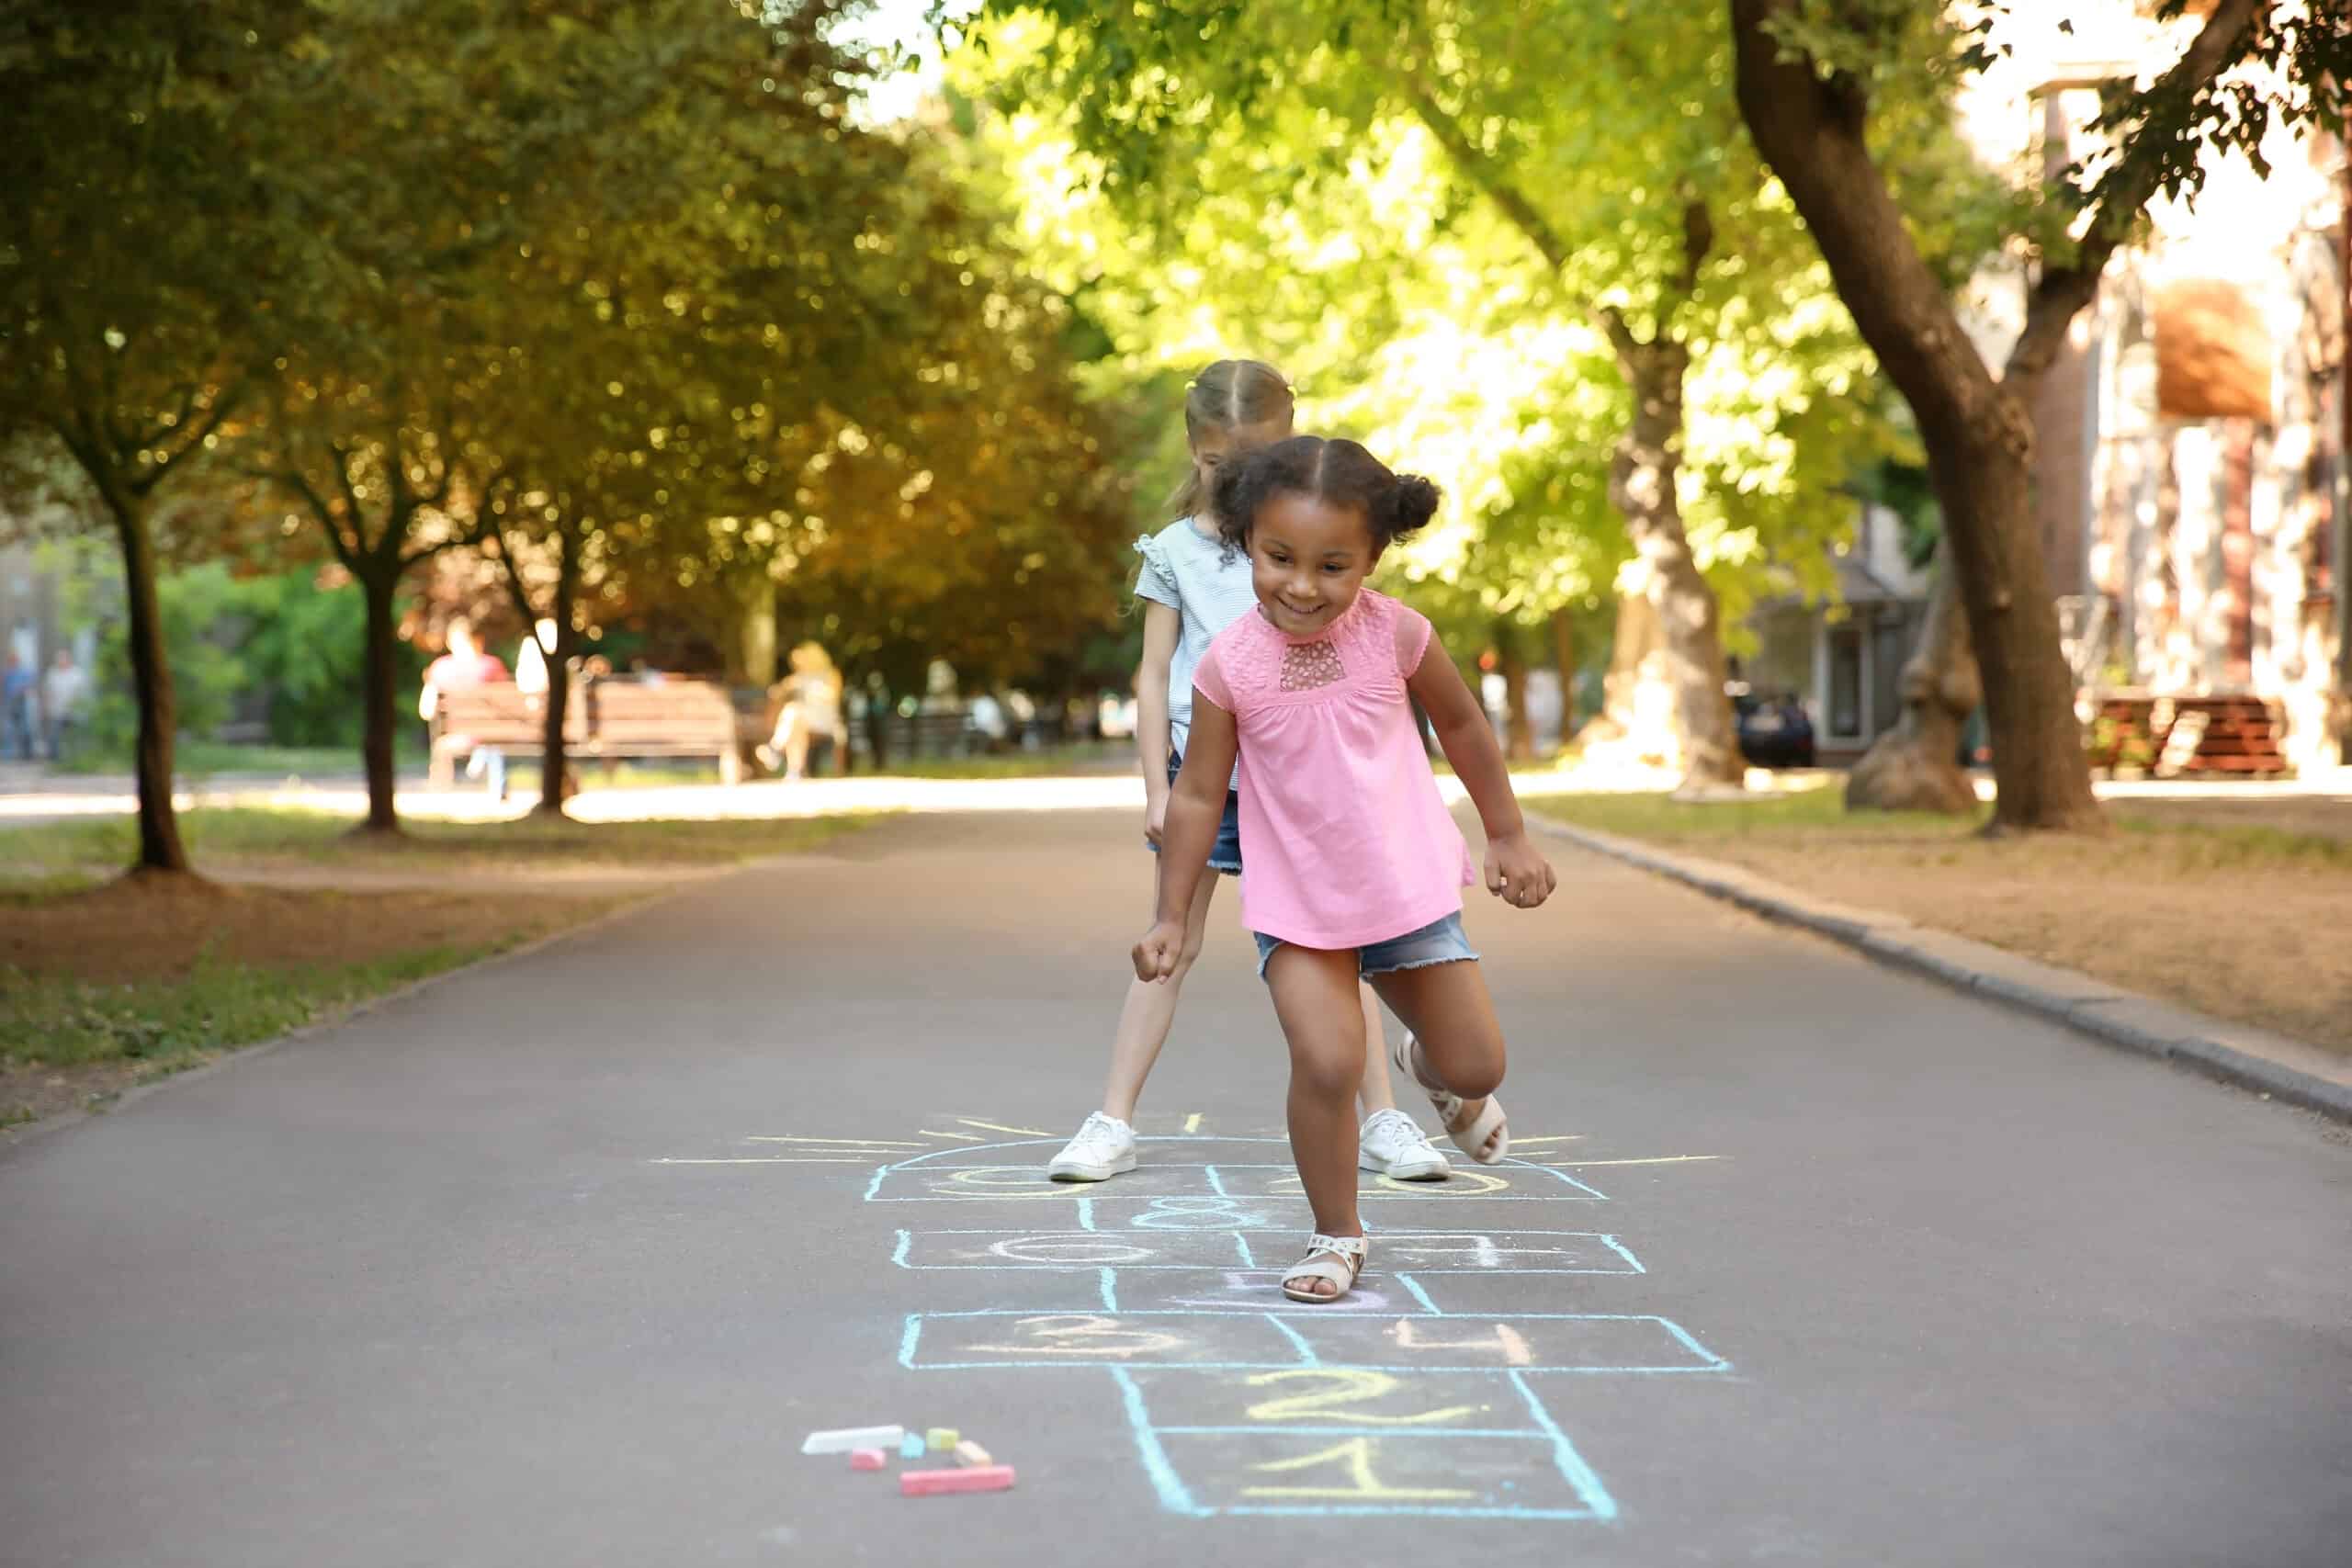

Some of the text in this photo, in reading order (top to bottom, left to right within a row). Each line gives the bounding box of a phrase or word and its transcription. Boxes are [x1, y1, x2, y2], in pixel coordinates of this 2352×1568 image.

[931, 1167, 1095, 1196] 9
[1130, 1197, 1266, 1229] 8
[989, 1234, 1159, 1262] 6
[1364, 1235, 1573, 1267] 7
[1165, 1271, 1389, 1309] 5
[961, 1314, 1180, 1358] 3
[1389, 1317, 1533, 1365] 4
[1244, 1368, 1481, 1426] 2
[1238, 1436, 1476, 1499] 1
